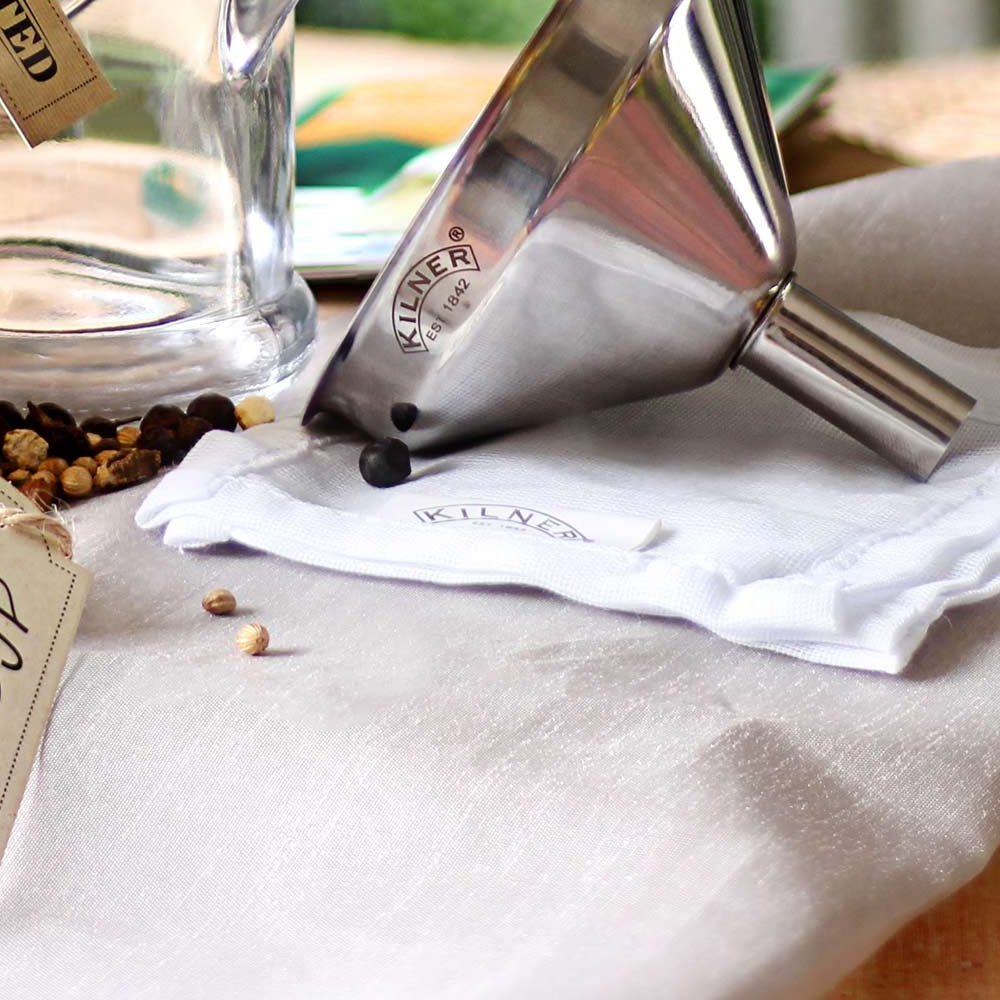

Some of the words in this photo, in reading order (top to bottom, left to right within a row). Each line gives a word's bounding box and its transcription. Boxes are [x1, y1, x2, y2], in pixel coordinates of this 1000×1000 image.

[425, 315, 449, 341] EST
[443, 278, 470, 312] 1842
[423, 507, 579, 541] KILNER
